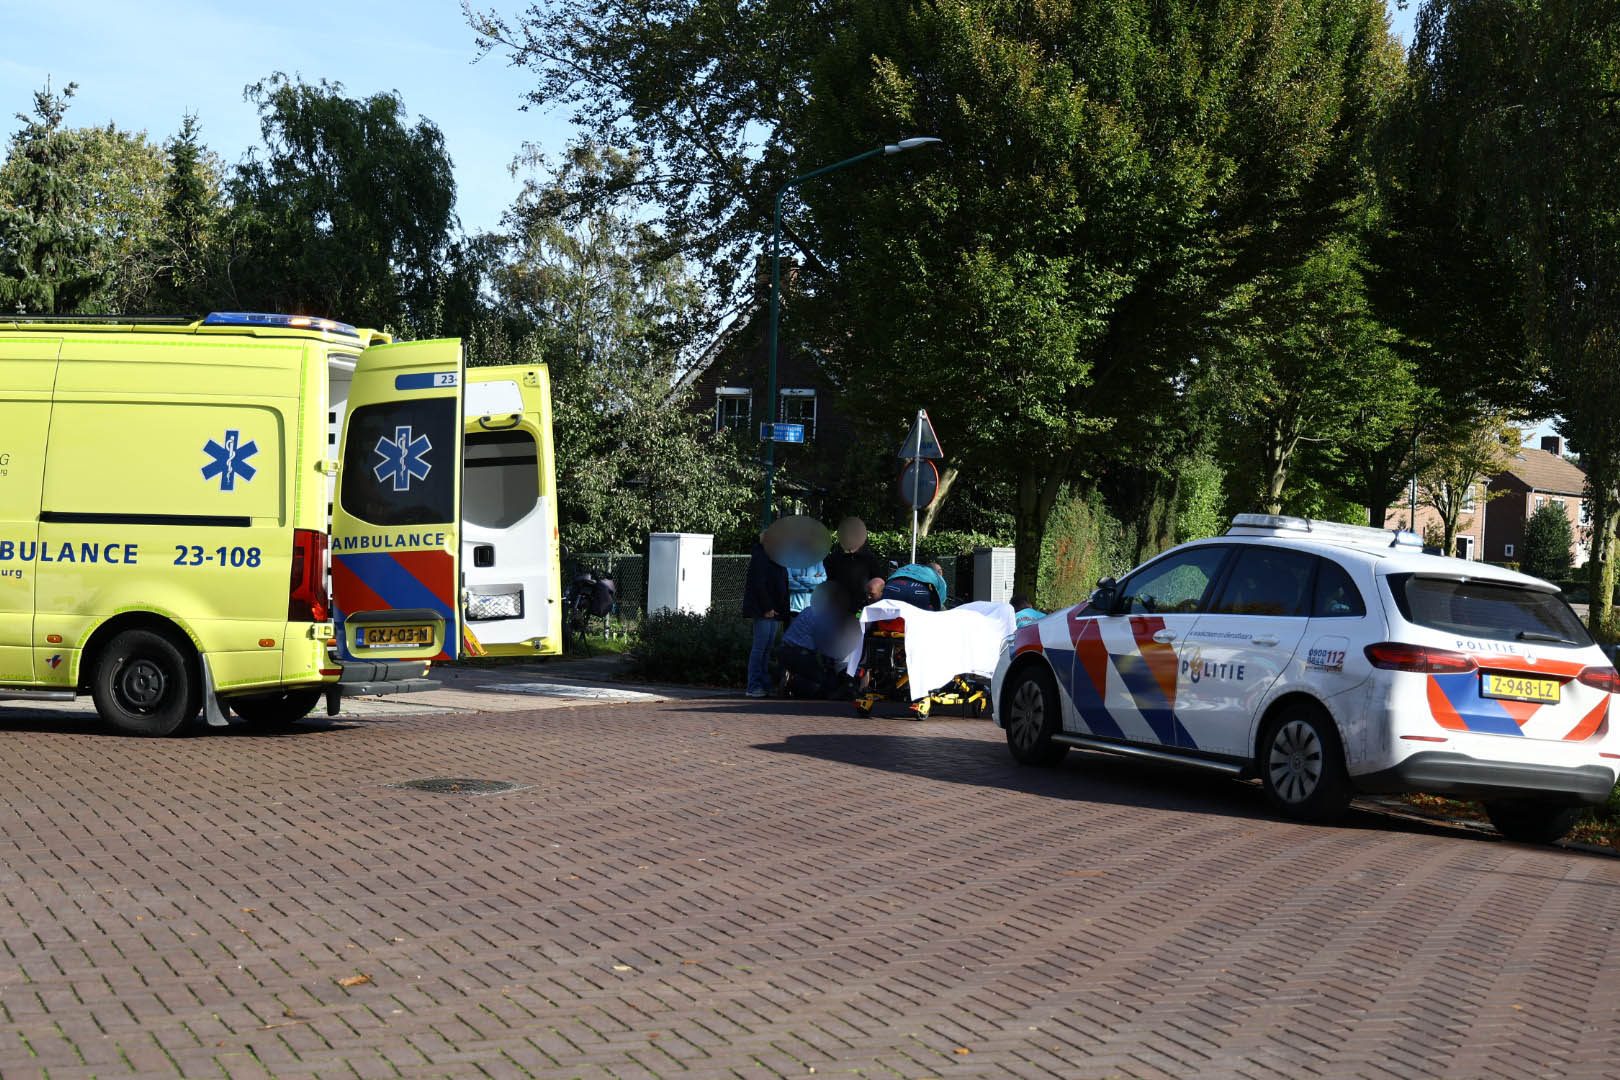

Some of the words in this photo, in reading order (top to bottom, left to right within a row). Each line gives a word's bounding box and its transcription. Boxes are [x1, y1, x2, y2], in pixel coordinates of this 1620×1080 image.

[331, 532, 445, 550] AMBULANCE
[0, 540, 138, 564] BULANCE
[173, 544, 262, 568] 23-108
[1456, 640, 1518, 653] POLITIE
[1327, 650, 1345, 664] 112
[1494, 677, 1553, 697] Z-948-LZ
